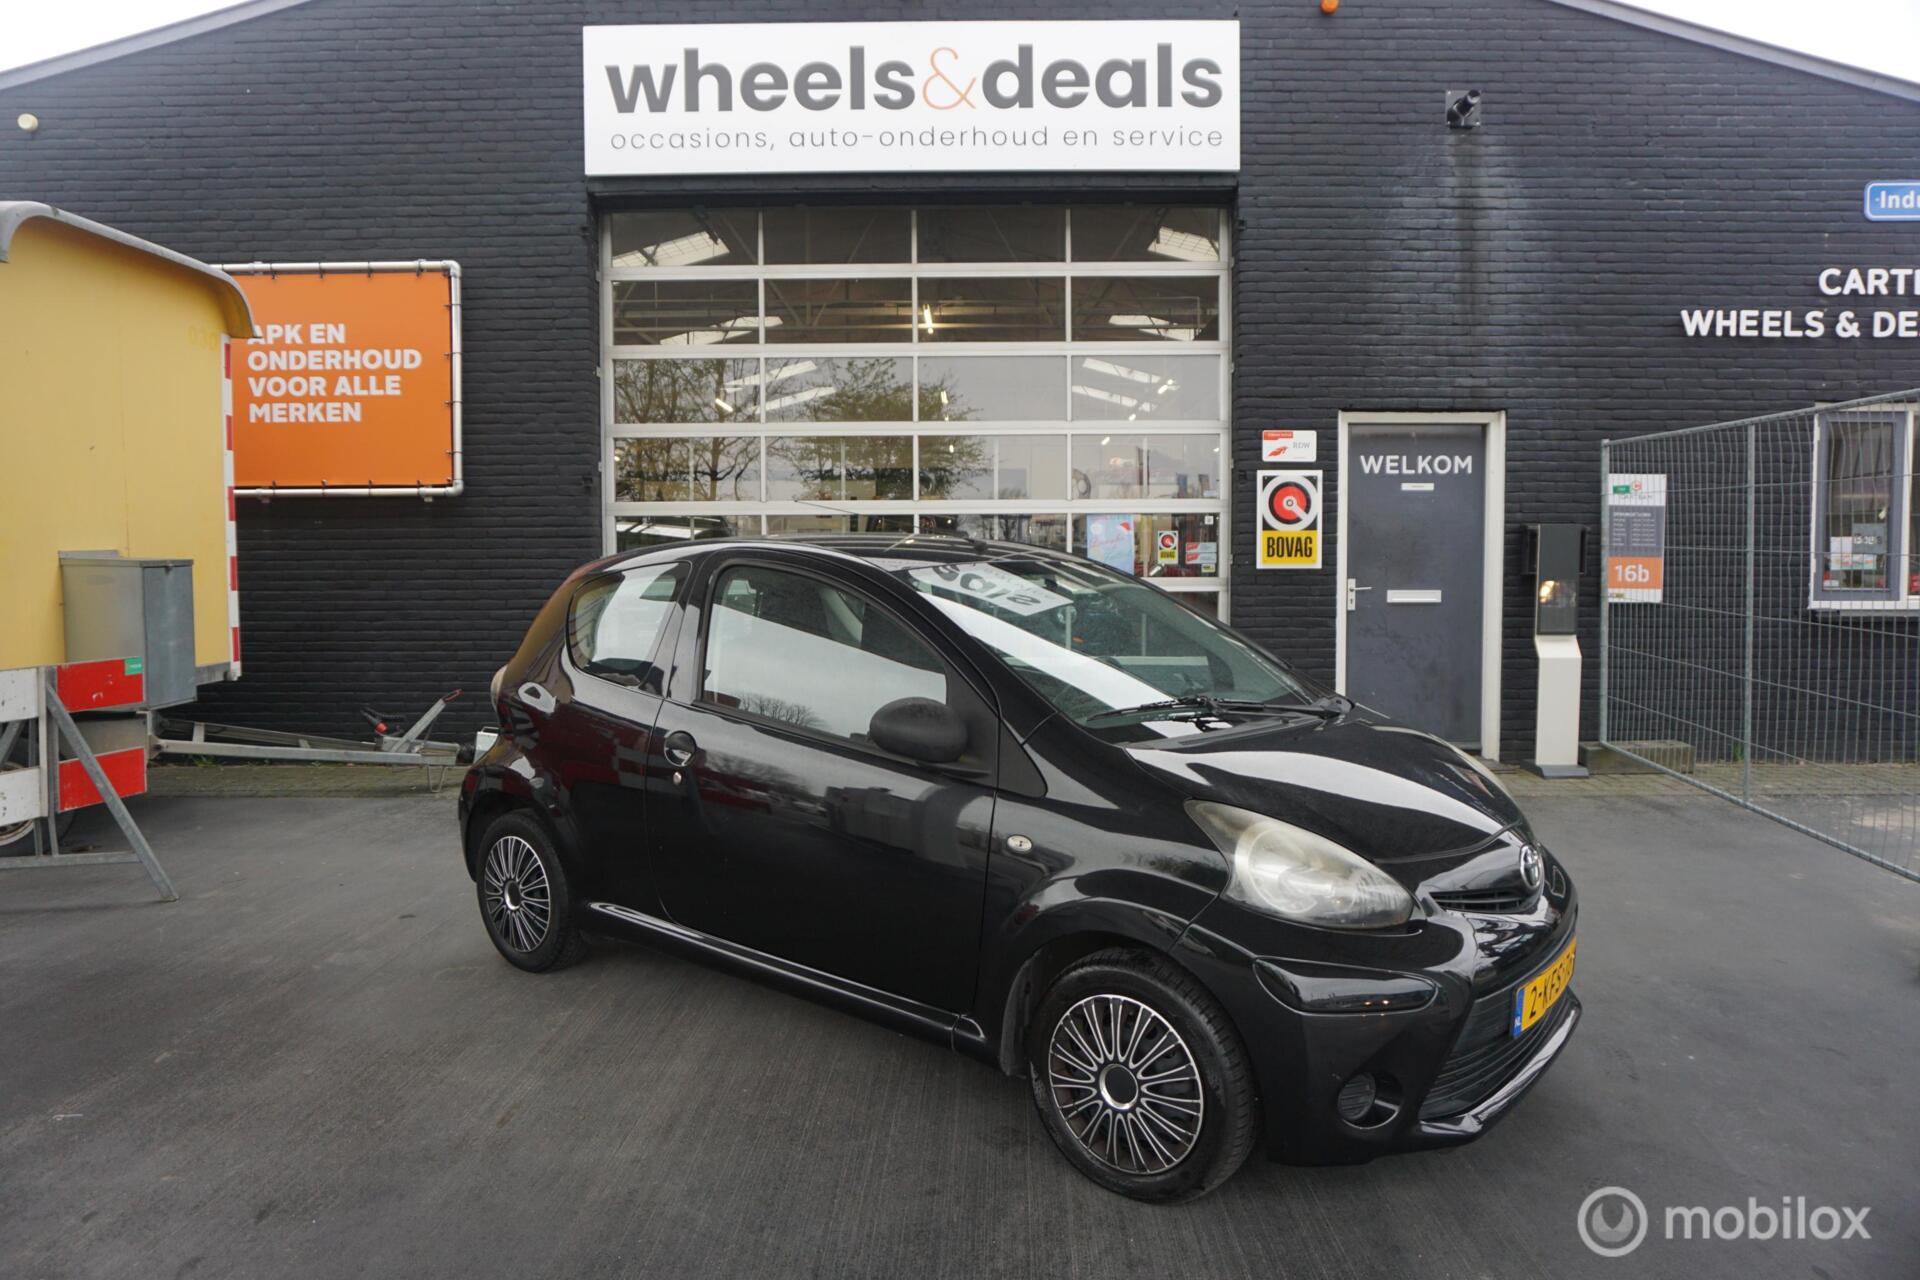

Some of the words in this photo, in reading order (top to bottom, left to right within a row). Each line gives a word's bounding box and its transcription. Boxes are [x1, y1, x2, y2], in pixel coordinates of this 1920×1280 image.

[605, 43, 1223, 114] wheels&deals
[610, 127, 775, 151] occasions,
[788, 126, 1048, 148] auto-onderhoud
[1062, 130, 1098, 146] en
[1113, 126, 1223, 147] service
[1880, 190, 1920, 209] Ind
[309, 324, 346, 344] EN
[1680, 309, 1825, 338] WHEELS
[1835, 310, 1861, 338] &
[1873, 310, 1920, 338] DE
[247, 349, 422, 372] ONDERHOUD
[247, 376, 327, 397] VOOR
[333, 375, 402, 396] ALLE
[249, 402, 362, 423] MERKEN
[1360, 455, 1473, 474] WELKOM
[1266, 536, 1313, 558] BOVAG
[1615, 564, 1650, 583] 16b
